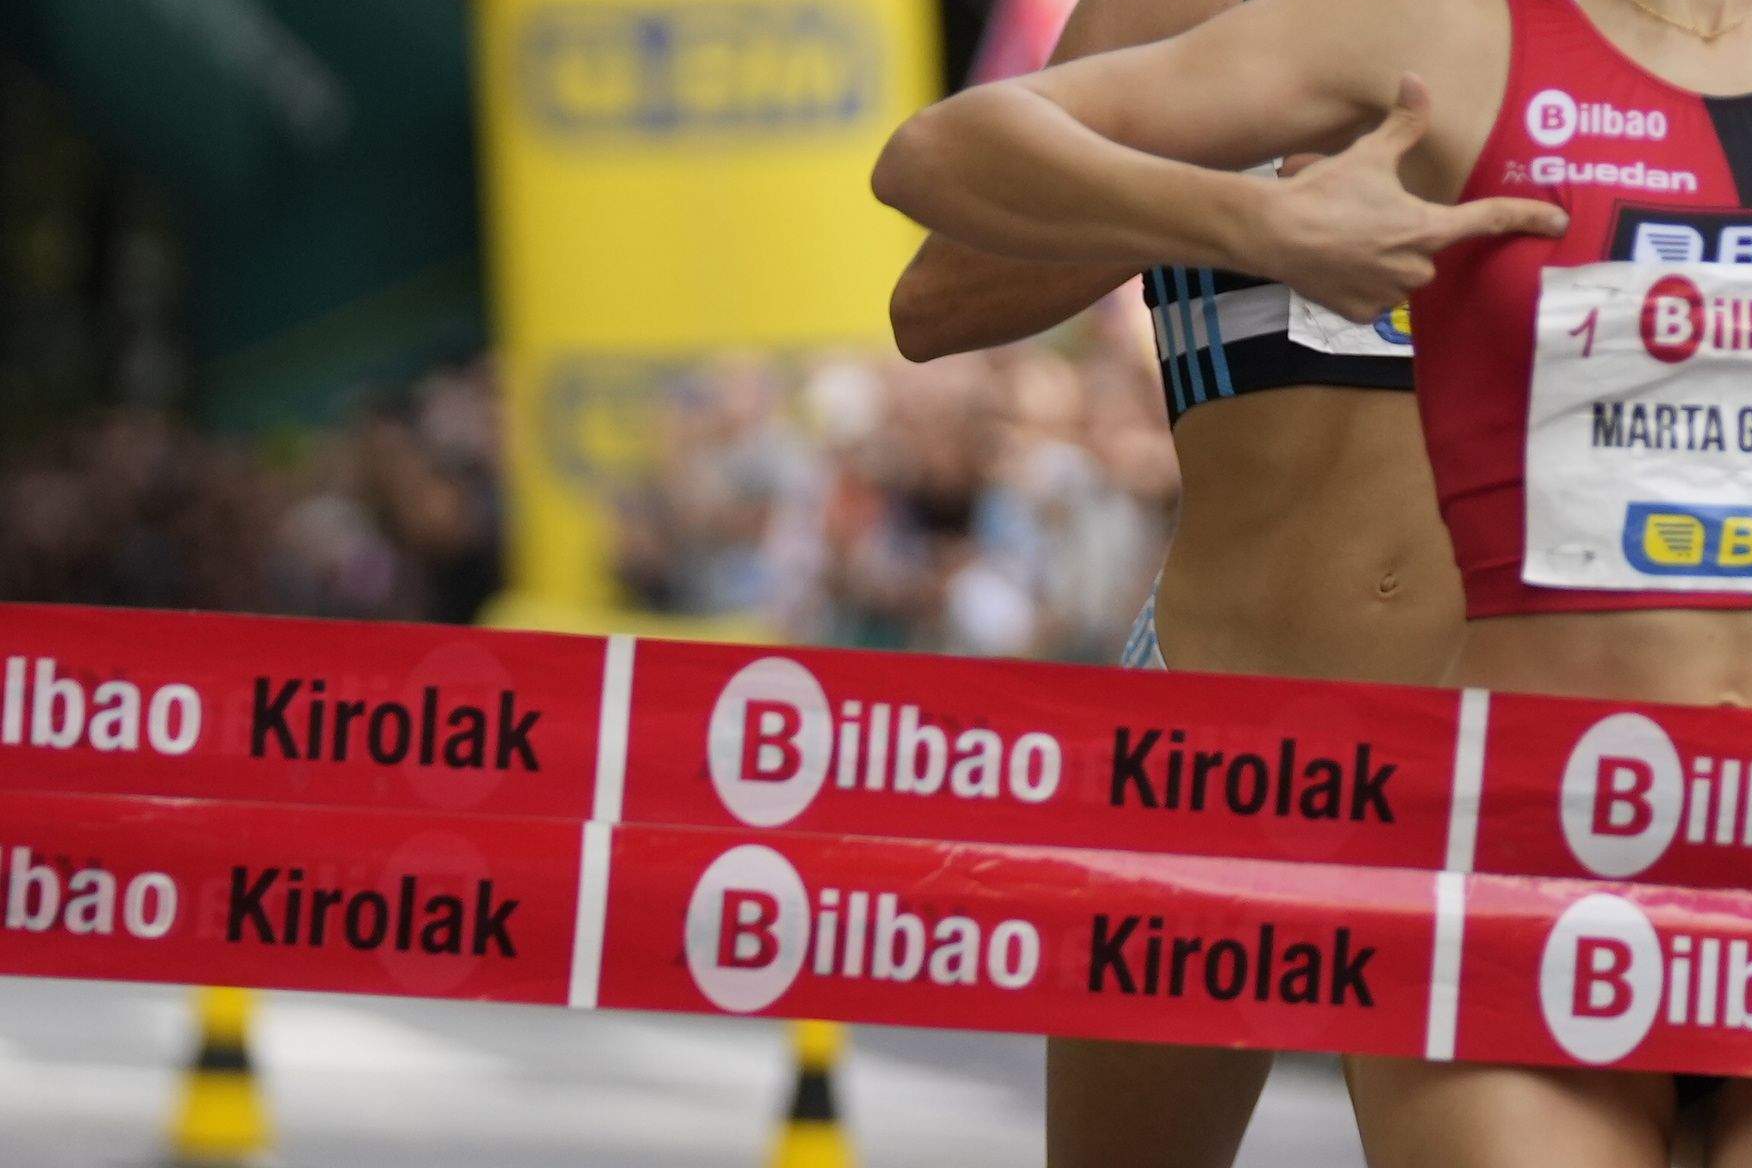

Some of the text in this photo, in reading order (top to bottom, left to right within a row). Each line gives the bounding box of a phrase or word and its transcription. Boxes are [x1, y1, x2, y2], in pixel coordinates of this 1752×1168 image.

[1538, 101, 1669, 144] Bilbao
[1531, 156, 1698, 192] Guedan
[1568, 308, 1600, 360] 1
[1591, 400, 1726, 452] MARTA
[249, 677, 541, 773] Kirolak
[737, 697, 1397, 825] Bilbao Kirolak
[0, 845, 520, 959] bao Kirolak
[714, 886, 1376, 1008] Bilbao Kirolak
